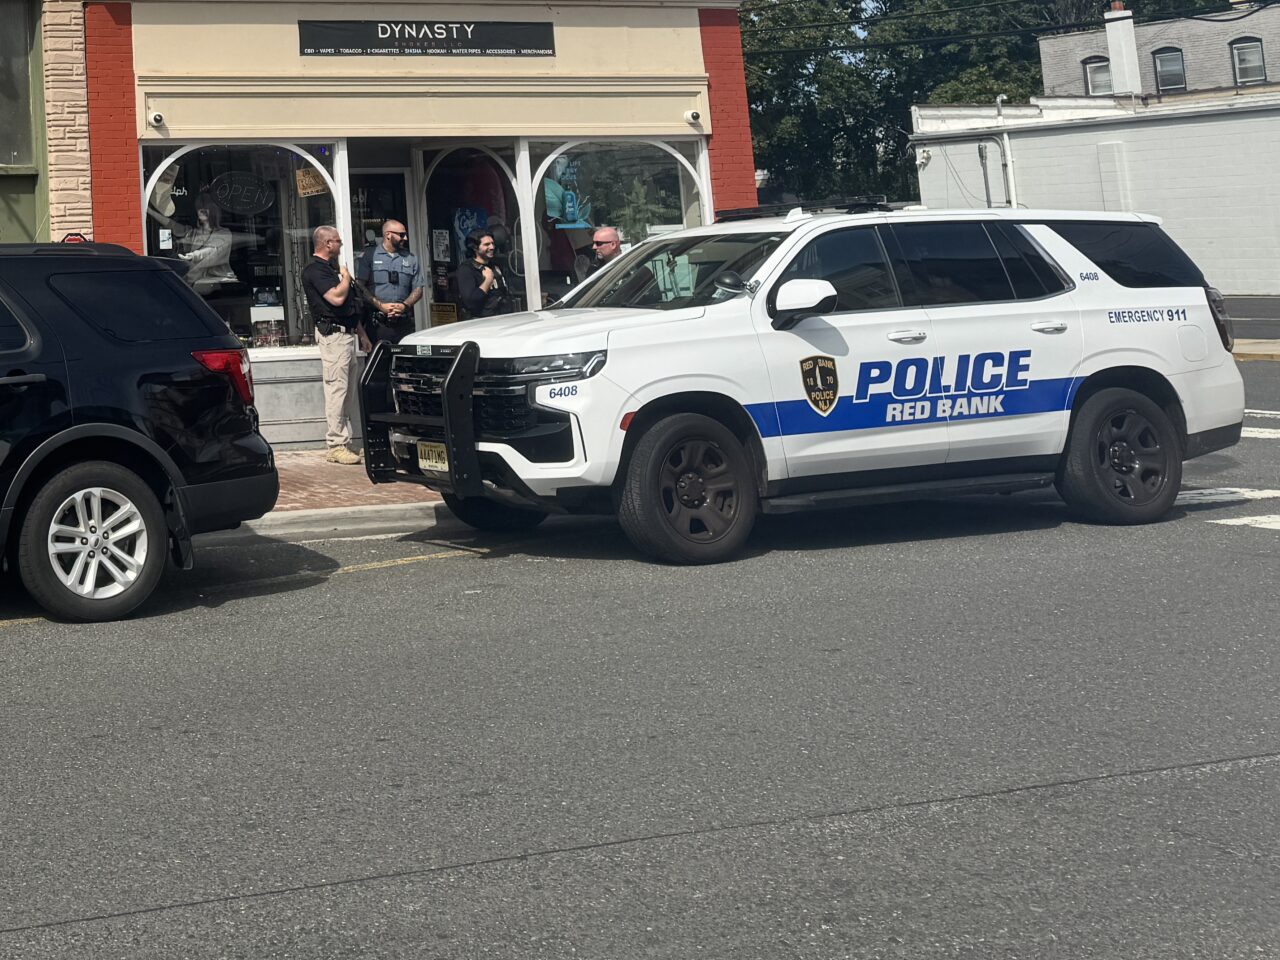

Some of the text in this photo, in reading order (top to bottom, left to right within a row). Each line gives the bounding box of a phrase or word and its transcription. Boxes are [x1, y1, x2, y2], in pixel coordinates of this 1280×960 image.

[378, 24, 474, 39] DYNASTY
[216, 183, 269, 204] OPEN
[1080, 272, 1099, 281] 6408
[1108, 308, 1187, 323] EMERGENCY 911
[802, 359, 834, 371] RED BANK
[826, 376, 833, 384] 70
[854, 349, 1032, 402] POLICE
[549, 385, 578, 398] 6408
[811, 391, 834, 400] POLICE
[886, 395, 1005, 422] RED BANK
